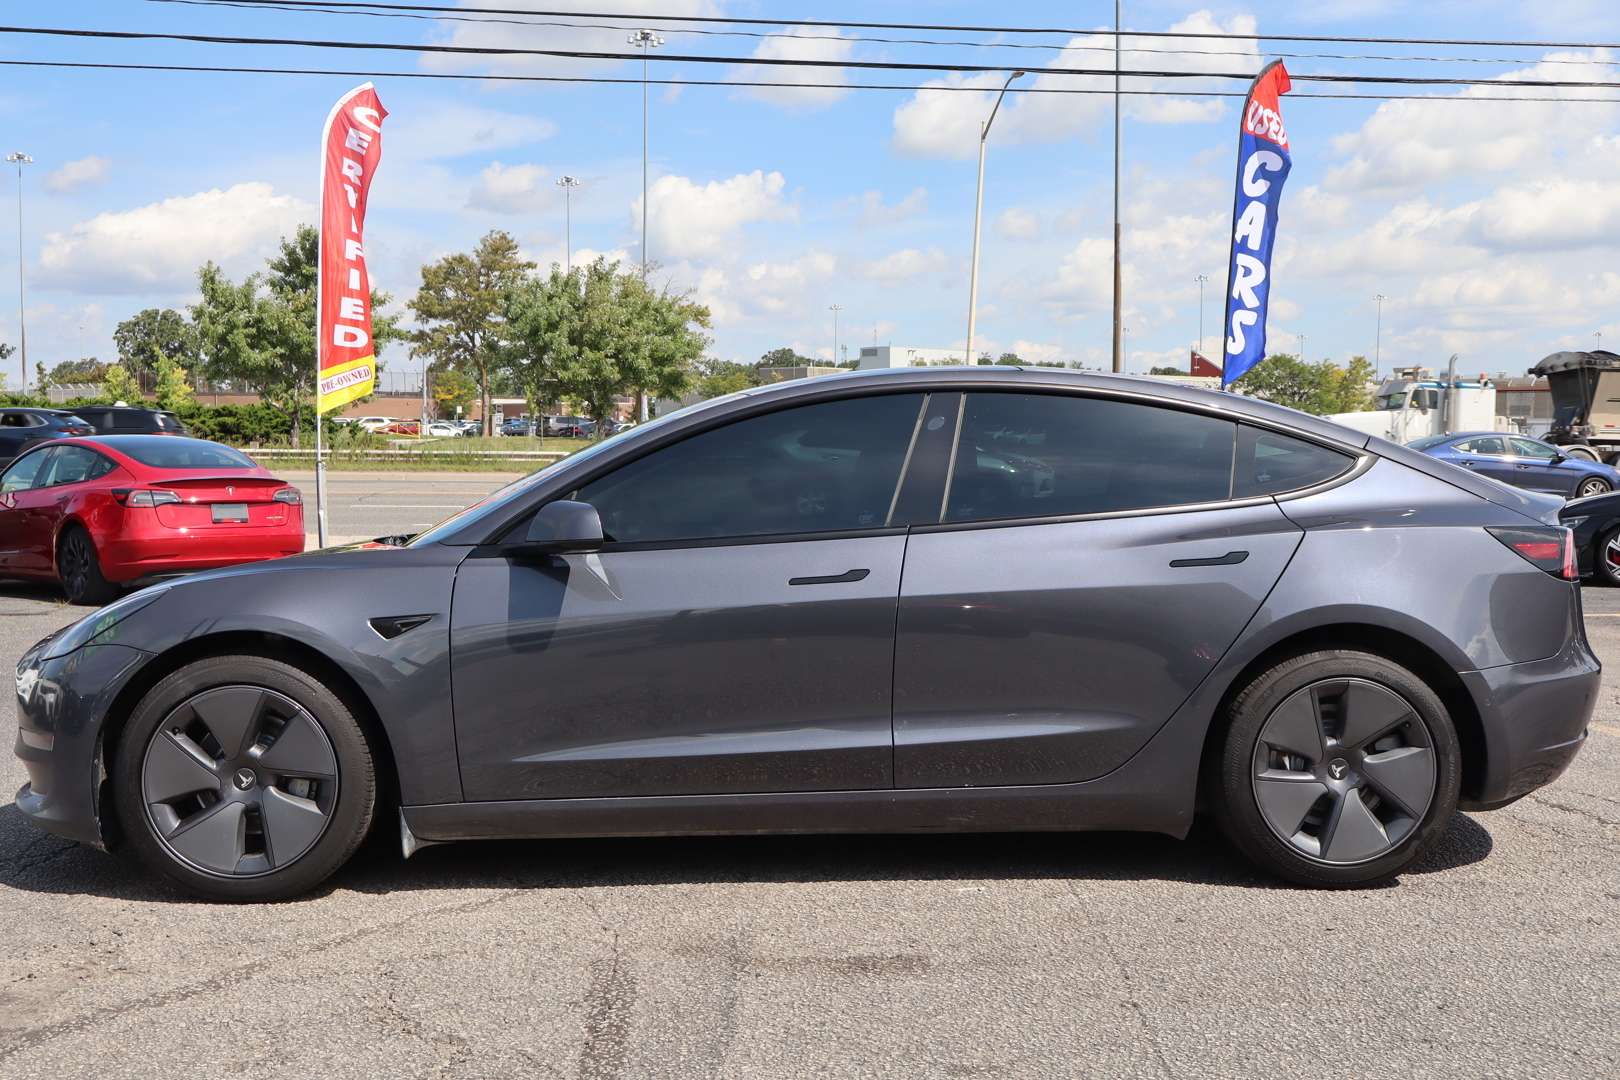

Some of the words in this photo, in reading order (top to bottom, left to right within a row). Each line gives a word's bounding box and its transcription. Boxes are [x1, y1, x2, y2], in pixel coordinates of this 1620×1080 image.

[1247, 100, 1287, 145] USED
[333, 106, 381, 348] CERTIFIED
[1226, 150, 1283, 355] CARS
[321, 367, 371, 393] PRE-OWNED
